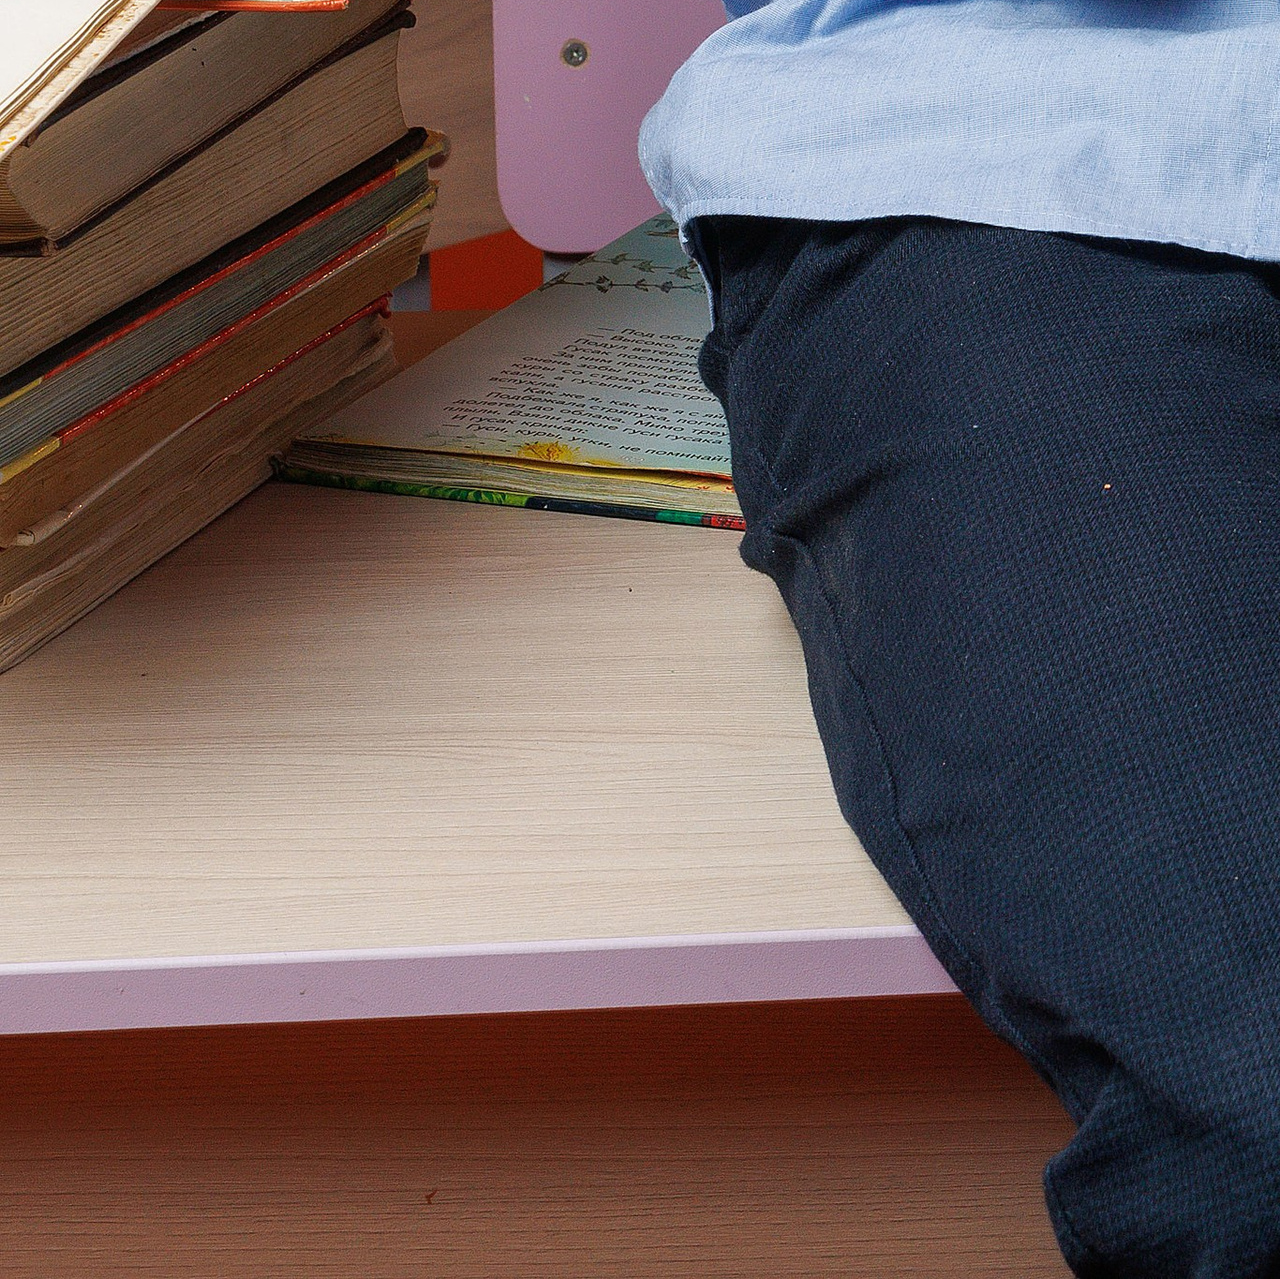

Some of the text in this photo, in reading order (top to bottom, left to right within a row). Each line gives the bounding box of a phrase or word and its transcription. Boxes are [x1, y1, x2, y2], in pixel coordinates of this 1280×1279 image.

[616, 352, 699, 368] посмотре
[677, 418, 728, 429] погна
[644, 448, 731, 463] поминайт
